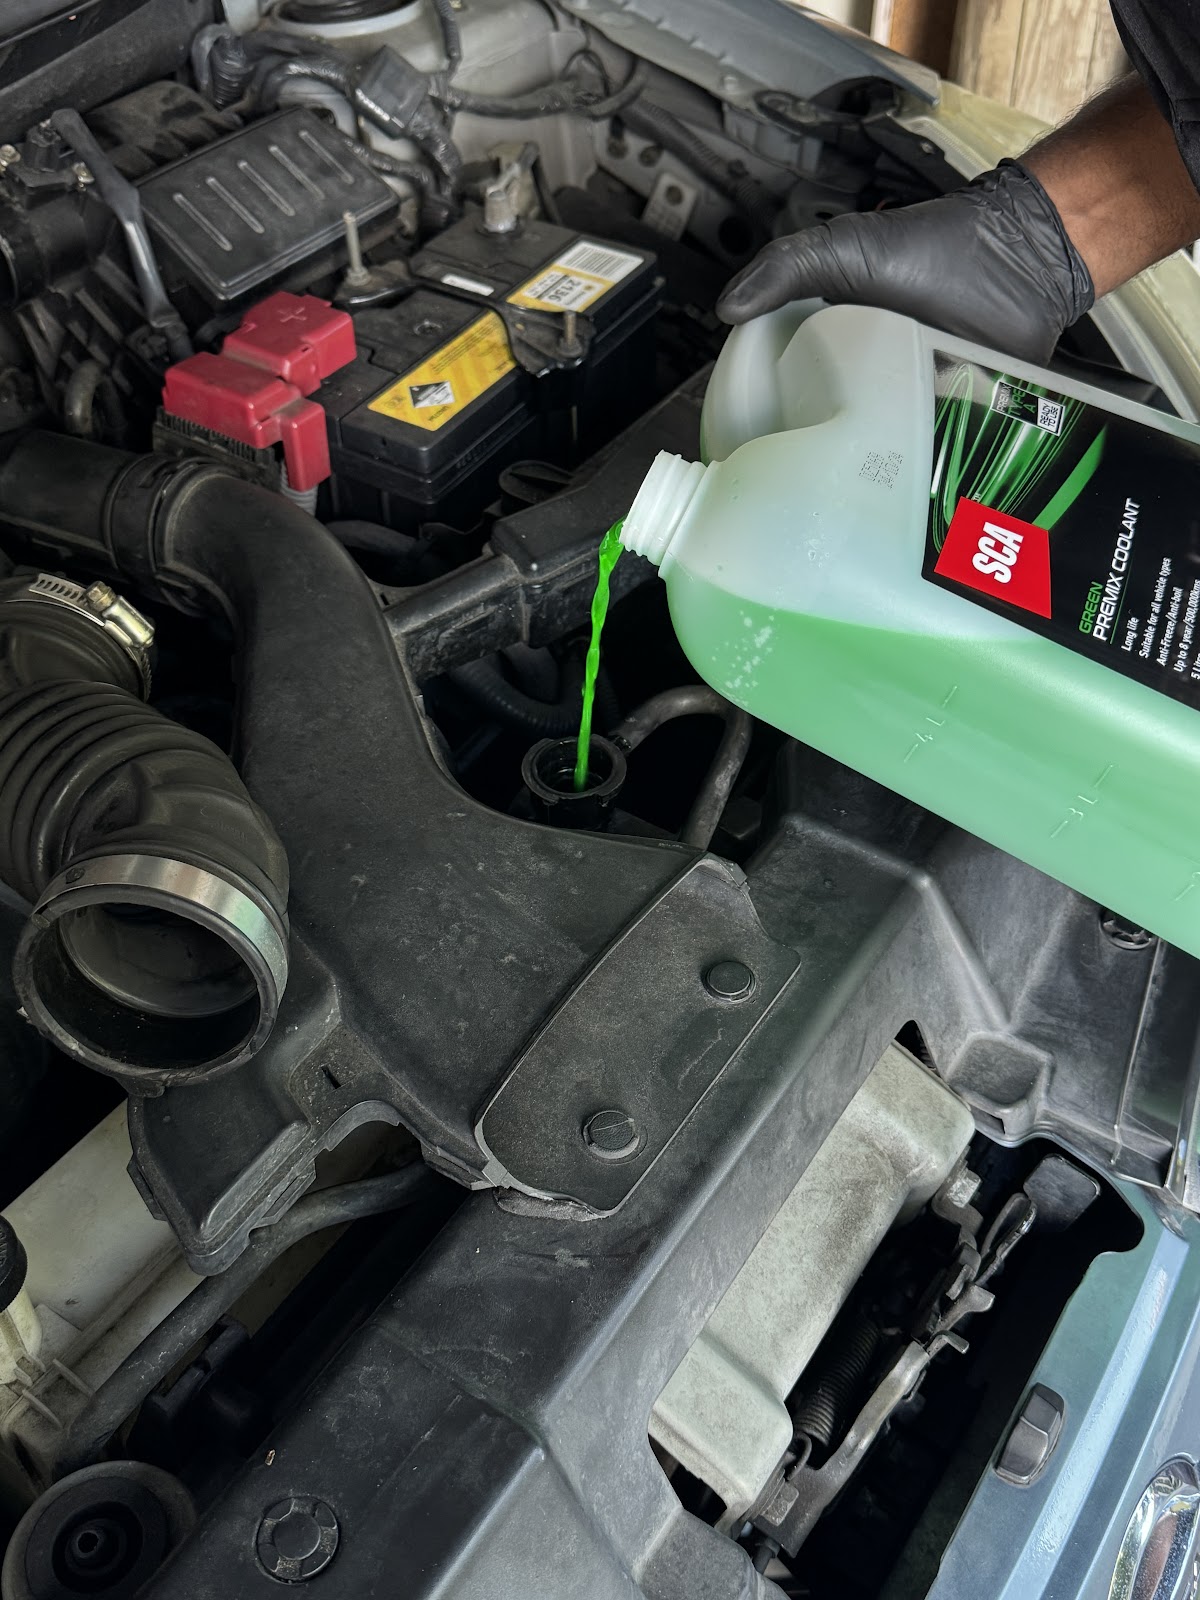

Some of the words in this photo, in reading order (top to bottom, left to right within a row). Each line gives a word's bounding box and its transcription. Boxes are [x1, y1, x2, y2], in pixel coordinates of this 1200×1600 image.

[996, 383, 1011, 412] PREMIX
[1008, 388, 1025, 415] TYPE
[1023, 403, 1036, 414] A
[1040, 402, 1050, 425] READY
[1050, 406, 1059, 419] USE
[1047, 417, 1056, 427] TO
[972, 521, 1024, 584] SCA
[1093, 572, 1124, 641] PREMIX
[1112, 498, 1140, 572] COOLANT
[1159, 557, 1172, 576] types
[1154, 577, 1167, 602] vehicle
[1079, 581, 1103, 634] GREEN
[1151, 602, 1161, 613] all
[1127, 617, 1139, 630] life
[1147, 613, 1158, 625] for
[1156, 587, 1183, 666] Anti-Freeze/Anti-boil
[1121, 630, 1138, 652] Long
[1139, 625, 1155, 658] Suitable
[1179, 642, 1189, 650] 8
[1178, 650, 1188, 660] to
[1173, 660, 1187, 672] Up
[1191, 672, 1200, 680] 5
